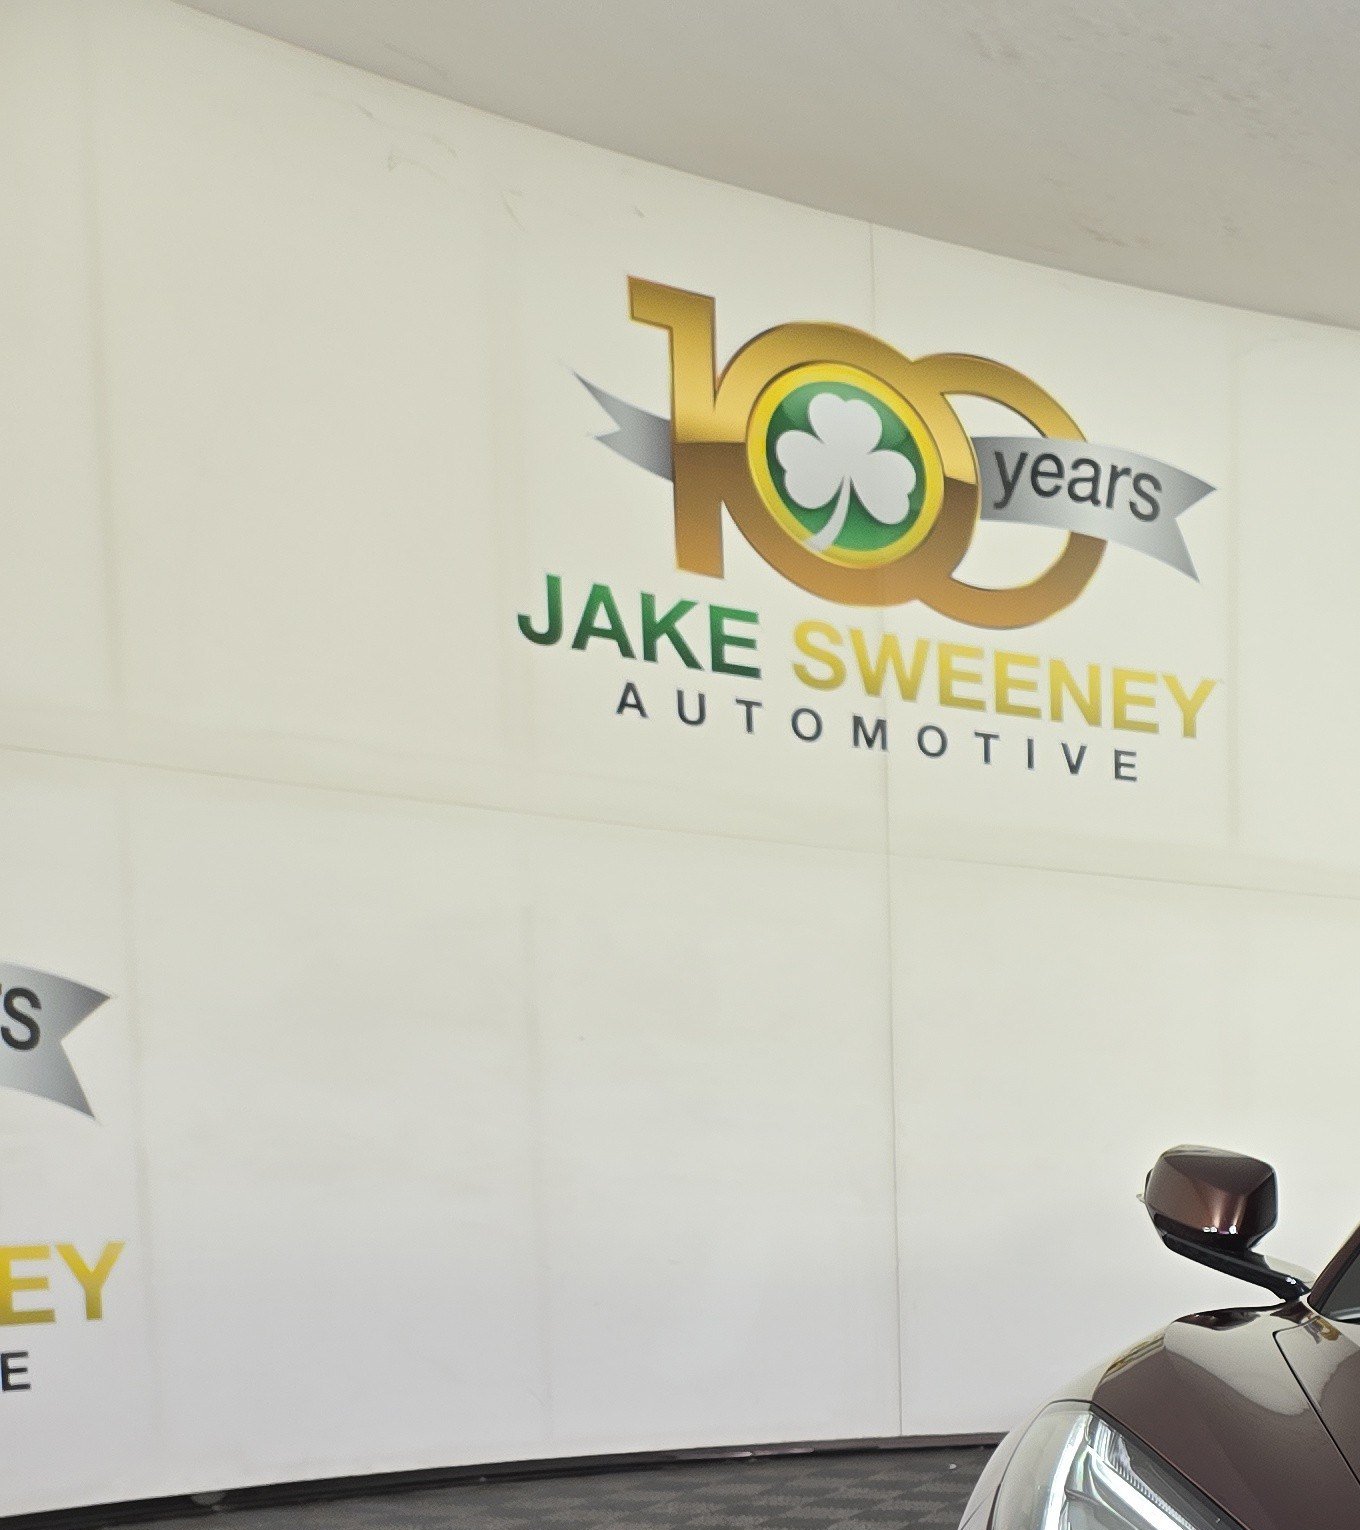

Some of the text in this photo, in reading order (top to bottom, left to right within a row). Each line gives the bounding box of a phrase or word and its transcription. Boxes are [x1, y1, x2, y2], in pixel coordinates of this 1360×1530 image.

[993, 449, 1163, 521] years
[517, 572, 1218, 738] JAKE SWEENEY
[616, 682, 1138, 782] AUTOMOTIVE
[0, 983, 42, 1051] s
